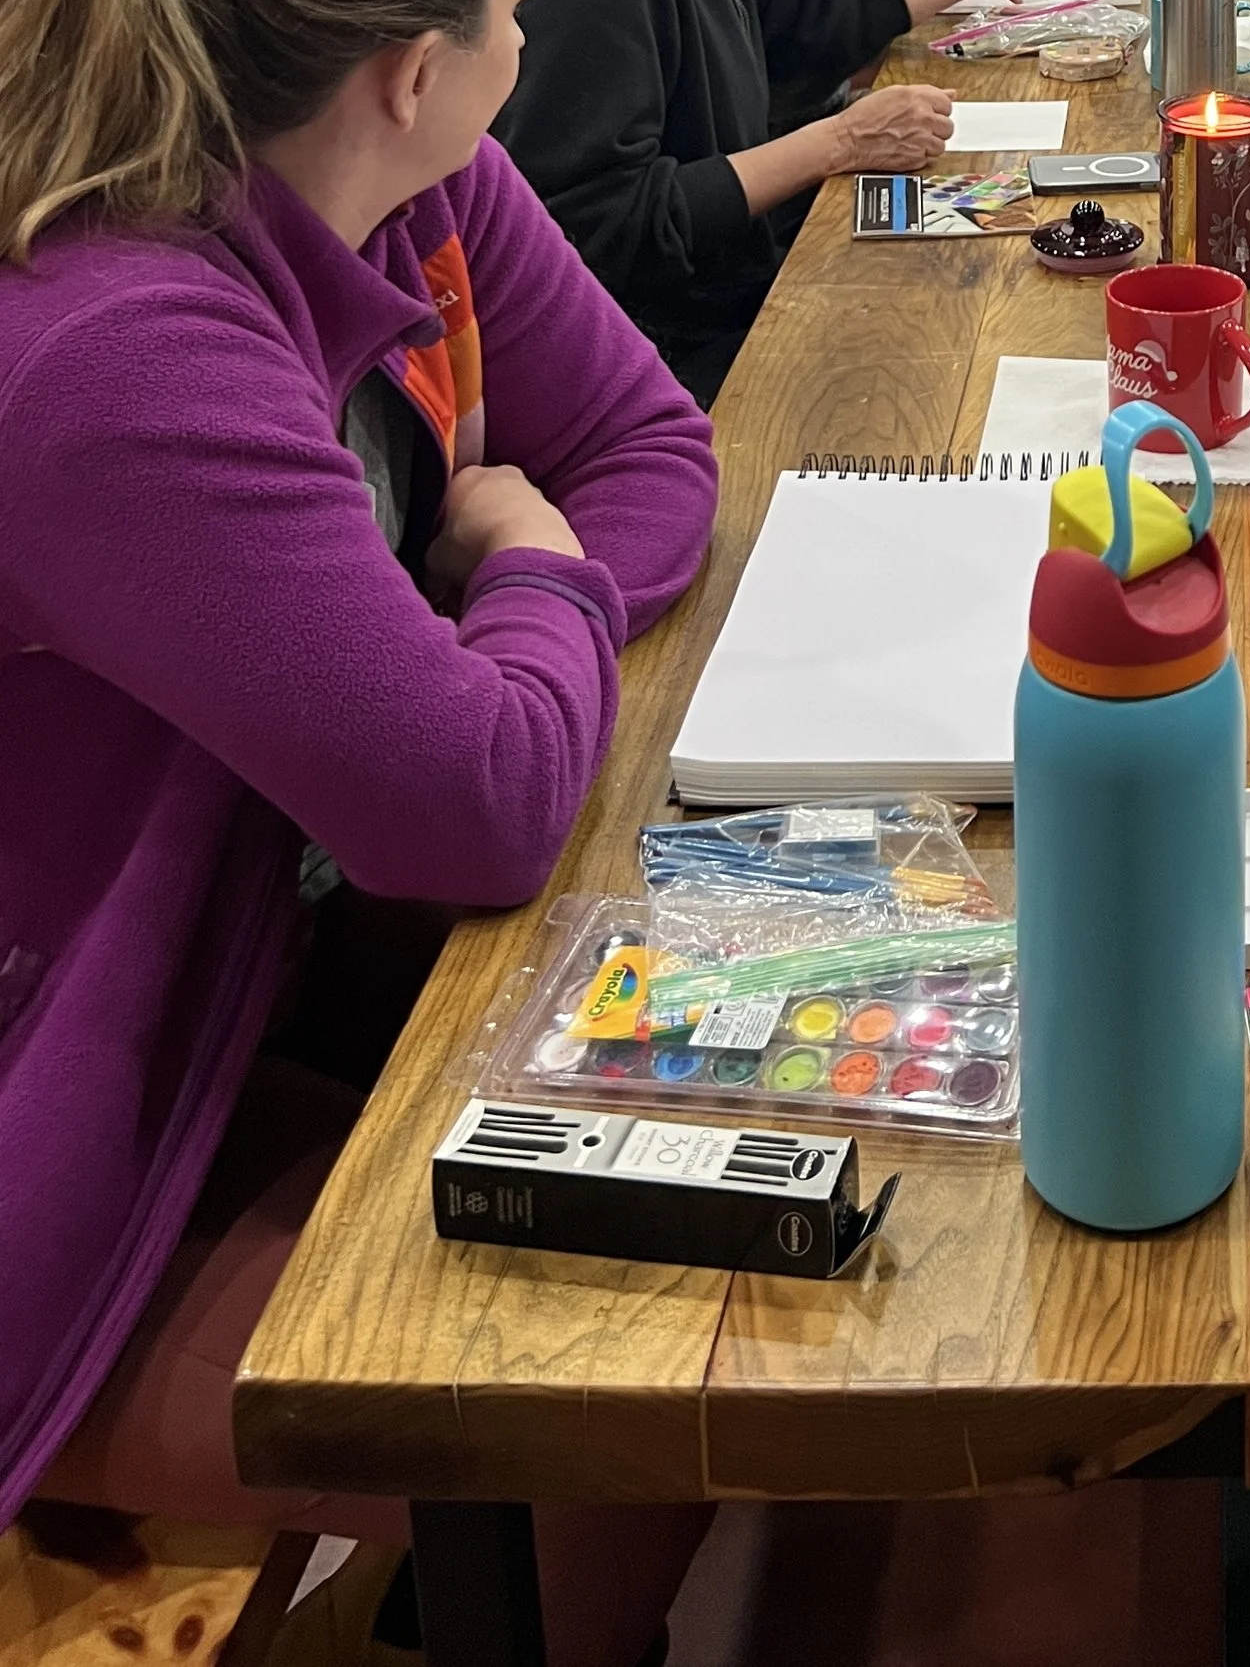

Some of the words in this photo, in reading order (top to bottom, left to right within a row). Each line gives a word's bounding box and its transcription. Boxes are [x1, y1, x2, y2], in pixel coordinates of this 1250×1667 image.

[1108, 334, 1152, 371] ama
[588, 969, 625, 1016] Crayola
[656, 1133, 692, 1165] 30
[701, 1139, 725, 1169] Willow
